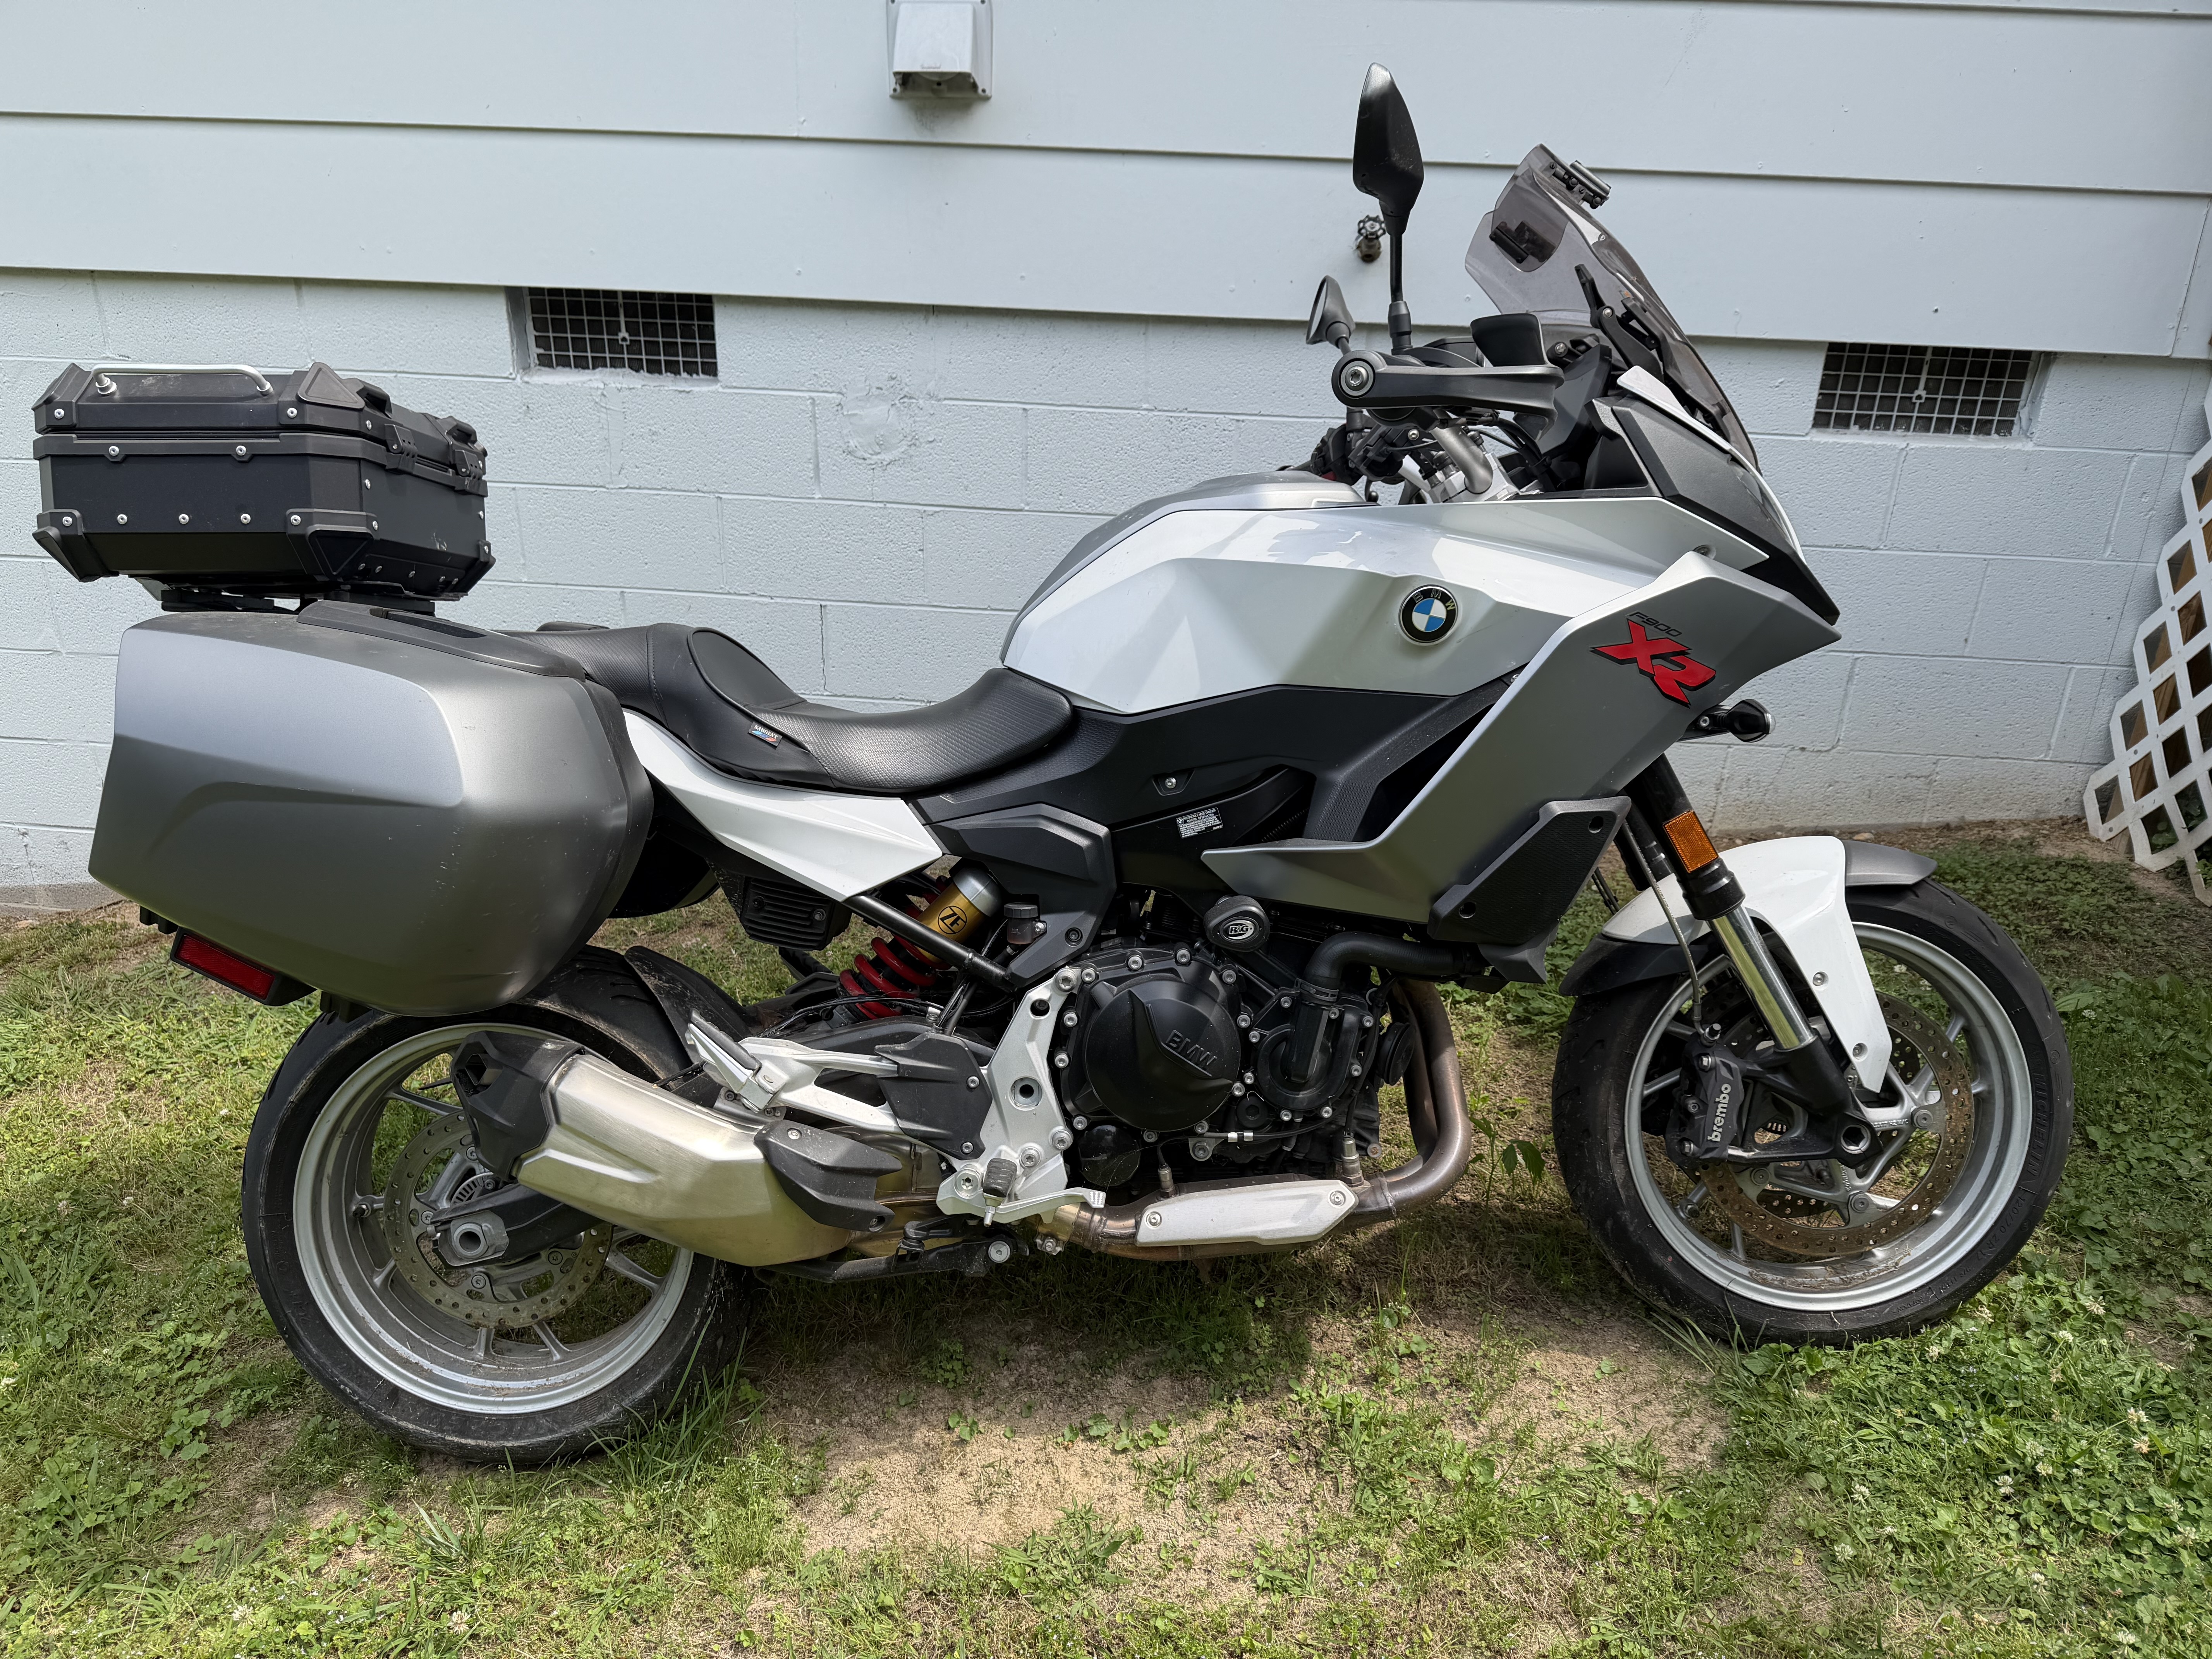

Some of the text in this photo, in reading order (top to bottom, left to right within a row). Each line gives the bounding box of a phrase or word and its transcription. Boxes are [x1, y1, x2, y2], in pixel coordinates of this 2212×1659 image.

[1413, 588, 1455, 610] BMW
[1629, 611, 1682, 637] F900
[1589, 620, 1716, 709] XR
[754, 725, 778, 739] SARGENT
[939, 908, 965, 931] ZF
[1229, 924, 1250, 934] R&G
[1166, 1029, 1218, 1066] BMW
[1707, 1083, 1731, 1142] brembo
[2027, 1073, 2048, 1177] MICHELIN
[1999, 1196, 2025, 1234] 120/70
